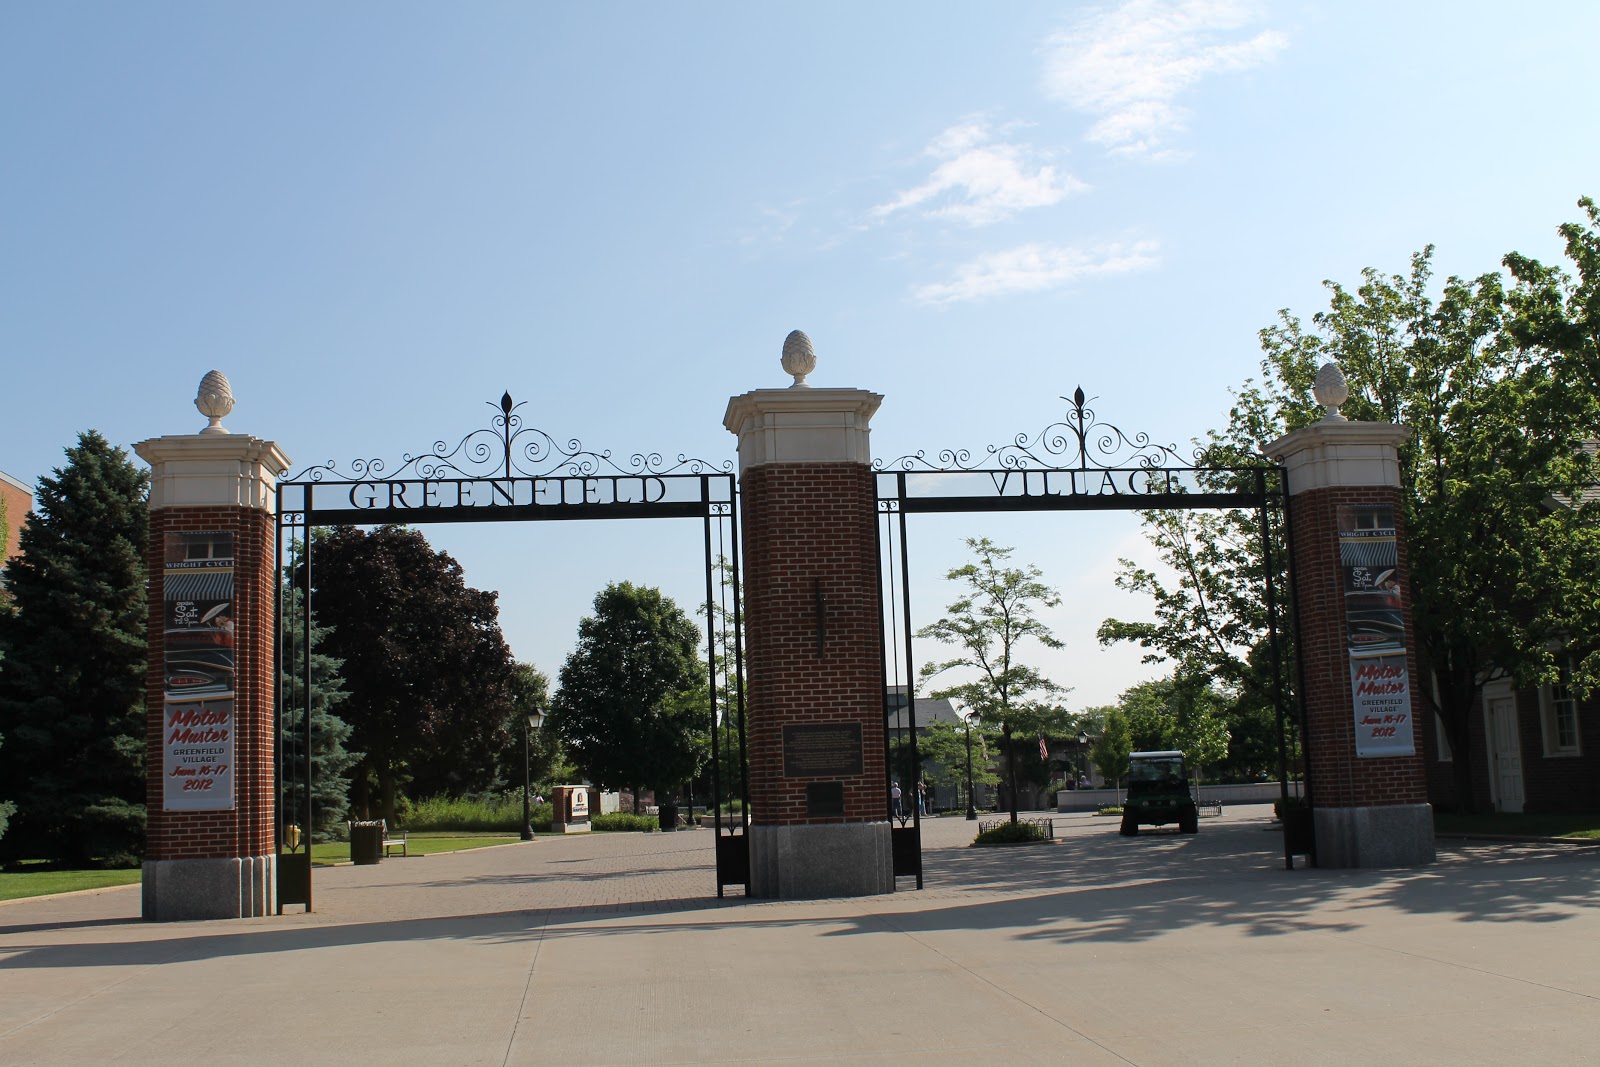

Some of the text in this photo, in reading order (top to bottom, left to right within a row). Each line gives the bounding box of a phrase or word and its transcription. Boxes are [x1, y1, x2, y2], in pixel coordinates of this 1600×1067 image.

[988, 470, 1187, 497] VILLAGE
[348, 477, 667, 509] GREENFIELD
[175, 605, 199, 618] Sat.
[1355, 664, 1405, 681] Motor
[1356, 681, 1406, 697] Muster
[168, 709, 230, 728] Motor
[1359, 715, 1382, 726] June
[167, 728, 230, 746] Muster
[1371, 726, 1397, 738] 2012
[173, 748, 225, 756] GREENFIELD
[169, 764, 229, 777] June 16-17
[182, 778, 214, 791] 2012
